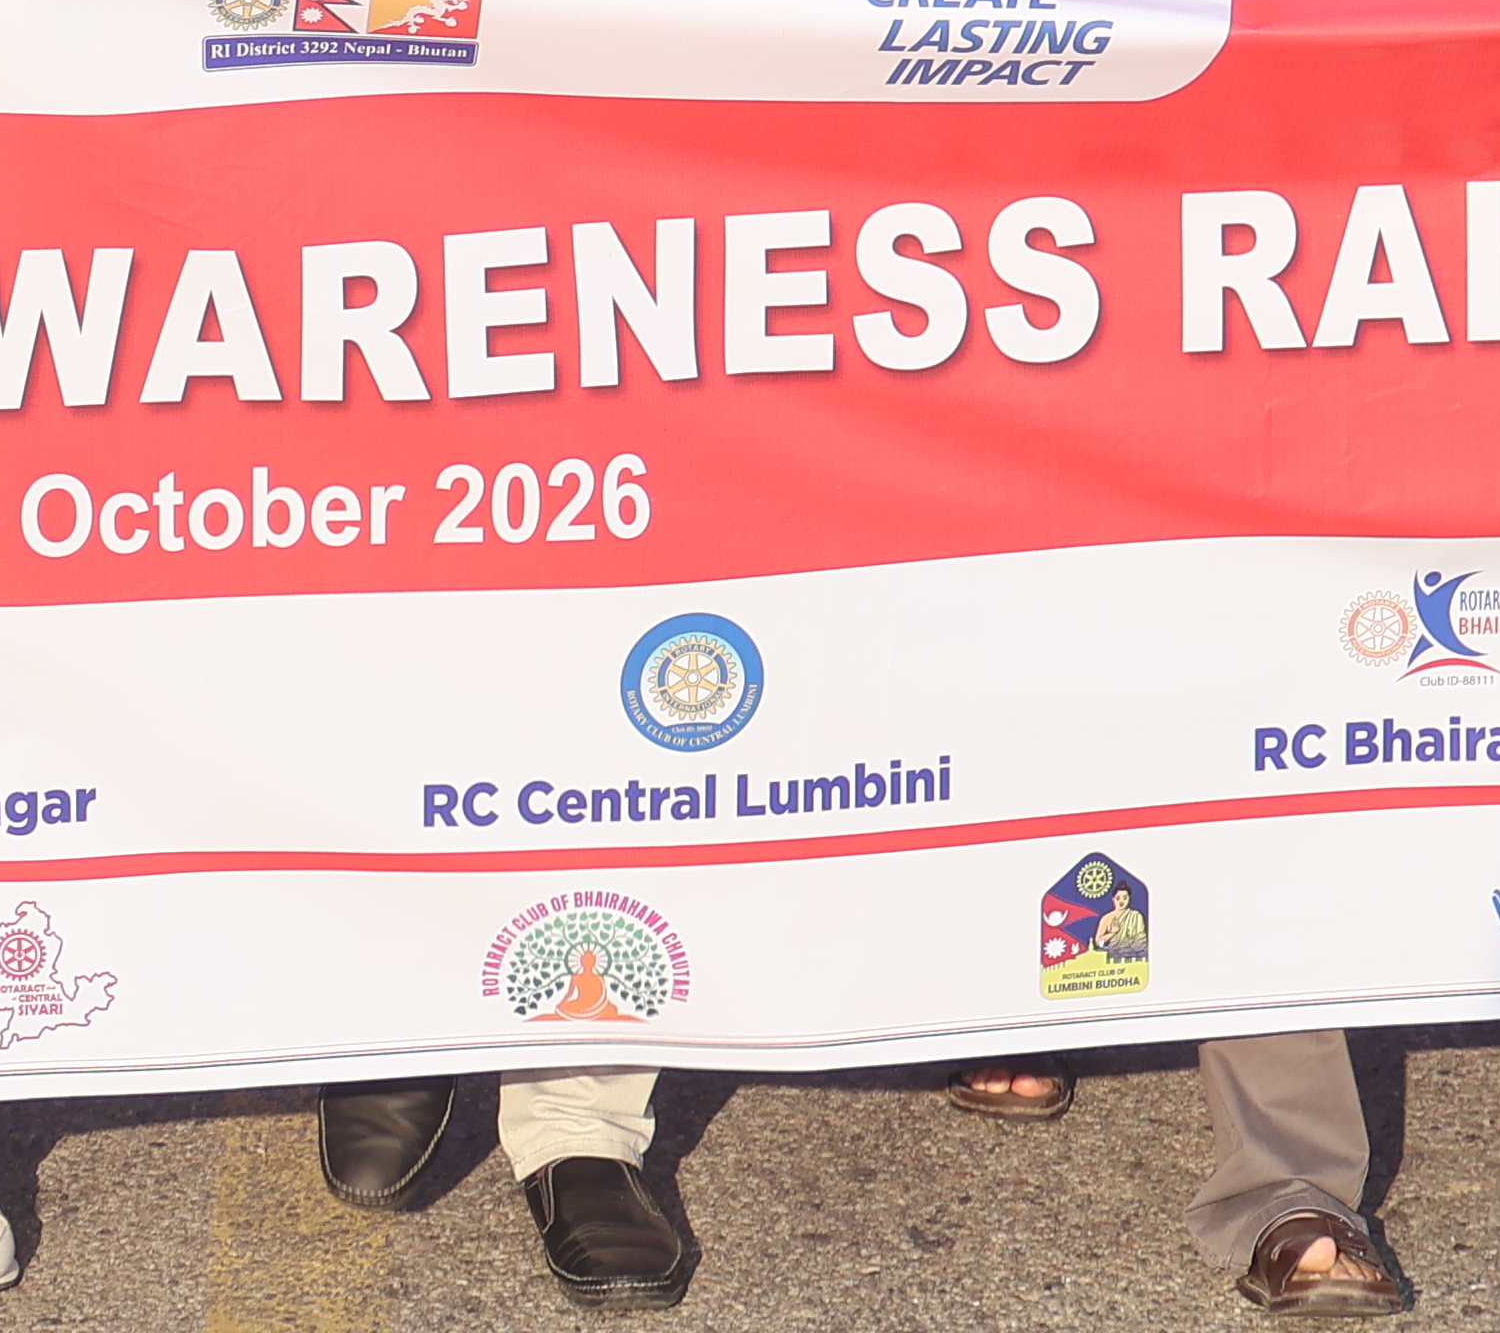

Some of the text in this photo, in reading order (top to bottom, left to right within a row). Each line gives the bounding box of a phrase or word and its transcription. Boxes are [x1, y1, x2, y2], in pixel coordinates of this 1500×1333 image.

[877, 19, 1113, 55] LASTING
[211, 42, 467, 59] RI District 3292 Nepal Bhutan
[884, 58, 1096, 88] IMPACT
[19, 465, 406, 559] October
[432, 452, 652, 546] 2026
[1419, 674, 1495, 687] Club ID-88111
[1253, 723, 1326, 771] RC
[422, 755, 952, 828] RC Central Lumbini
[481, 891, 690, 1003] ROTARACT CLUB OF BHAIRAHAWA CHAUTARI
[1048, 977, 1140, 993] LUMBINI BUDDHA
[1062, 971, 1097, 980] ROTARACT
[19, 994, 63, 1002] CENTRAL
[18, 1004, 63, 1016] SIYARI
